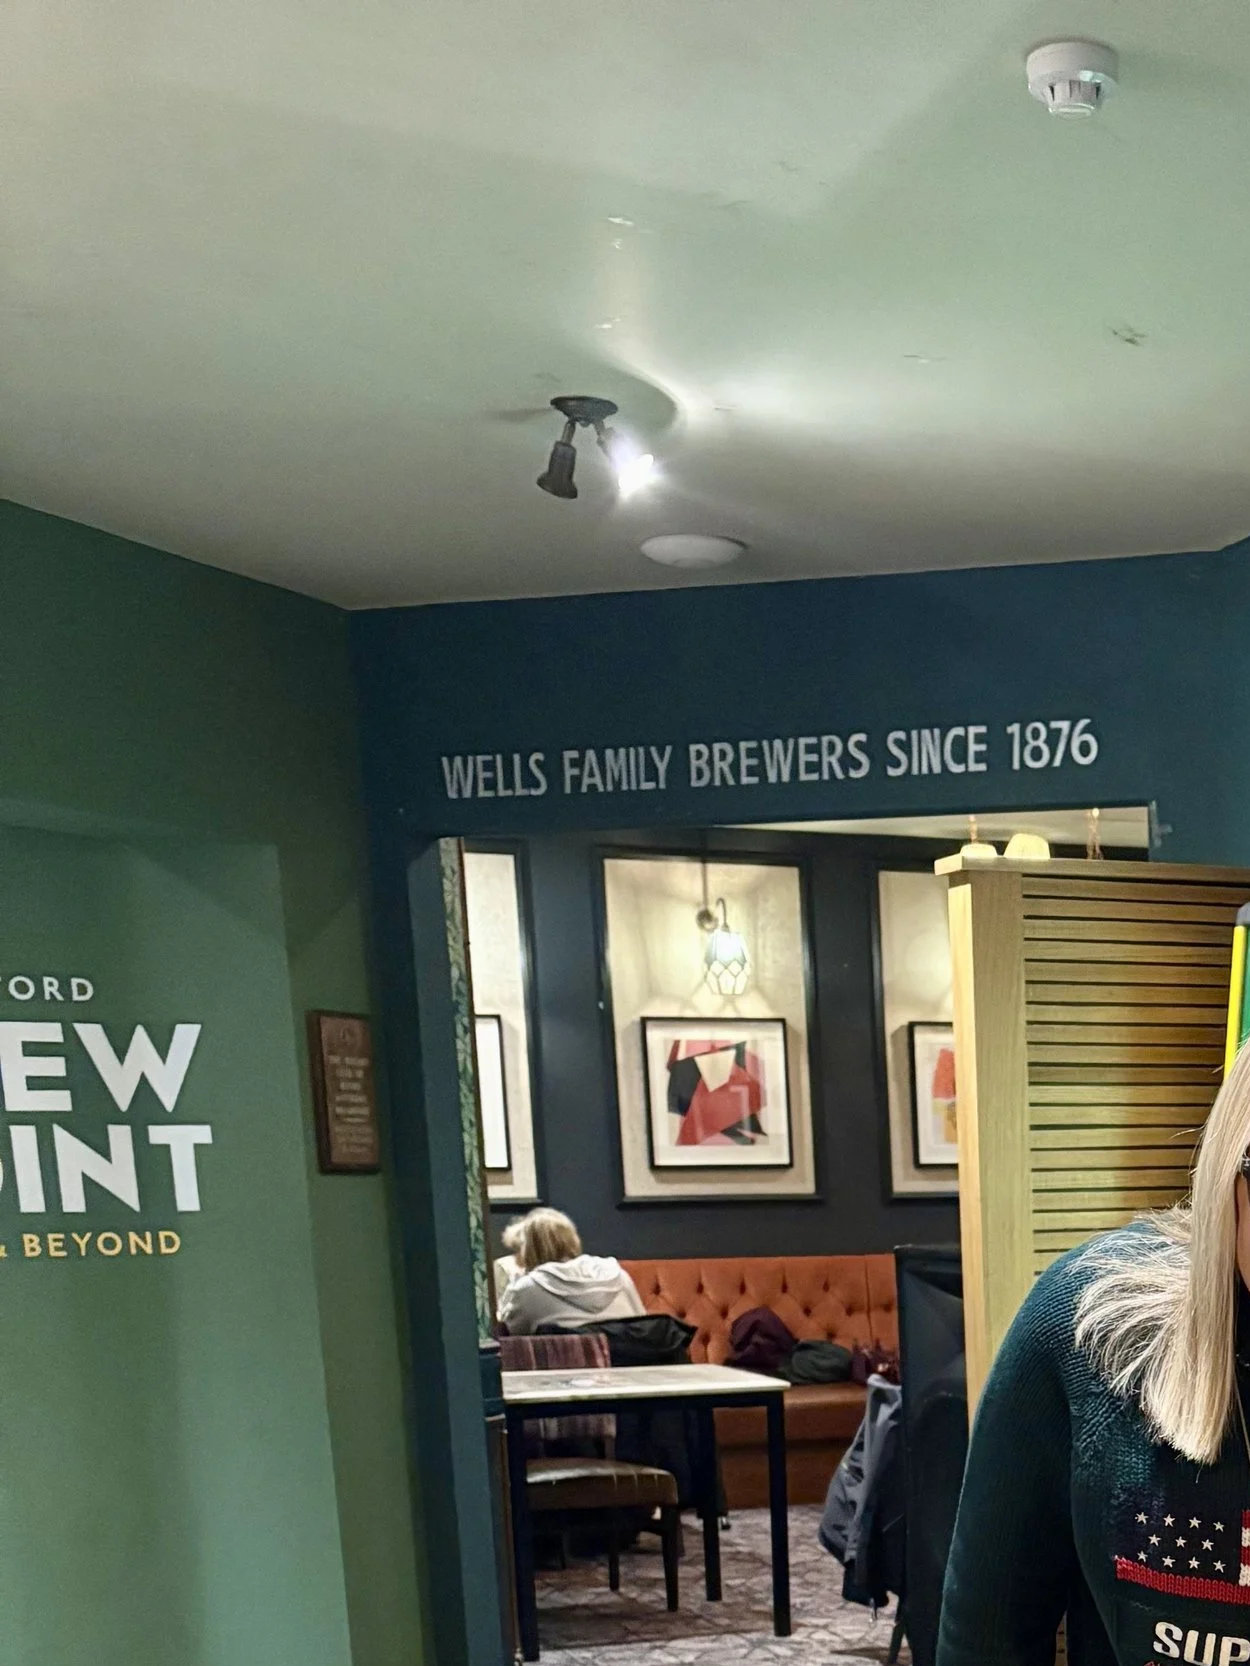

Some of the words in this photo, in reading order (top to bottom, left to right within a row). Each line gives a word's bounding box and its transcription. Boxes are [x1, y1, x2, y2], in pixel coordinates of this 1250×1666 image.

[441, 753, 547, 799] WELLS
[563, 746, 672, 794] FAMILY
[689, 732, 871, 787] BREWERS
[886, 725, 988, 777] SINCE
[1007, 719, 1099, 771] 1876
[0, 976, 94, 1001] ORD
[0, 1123, 213, 1213] INT
[22, 1231, 181, 1258] BEYOND
